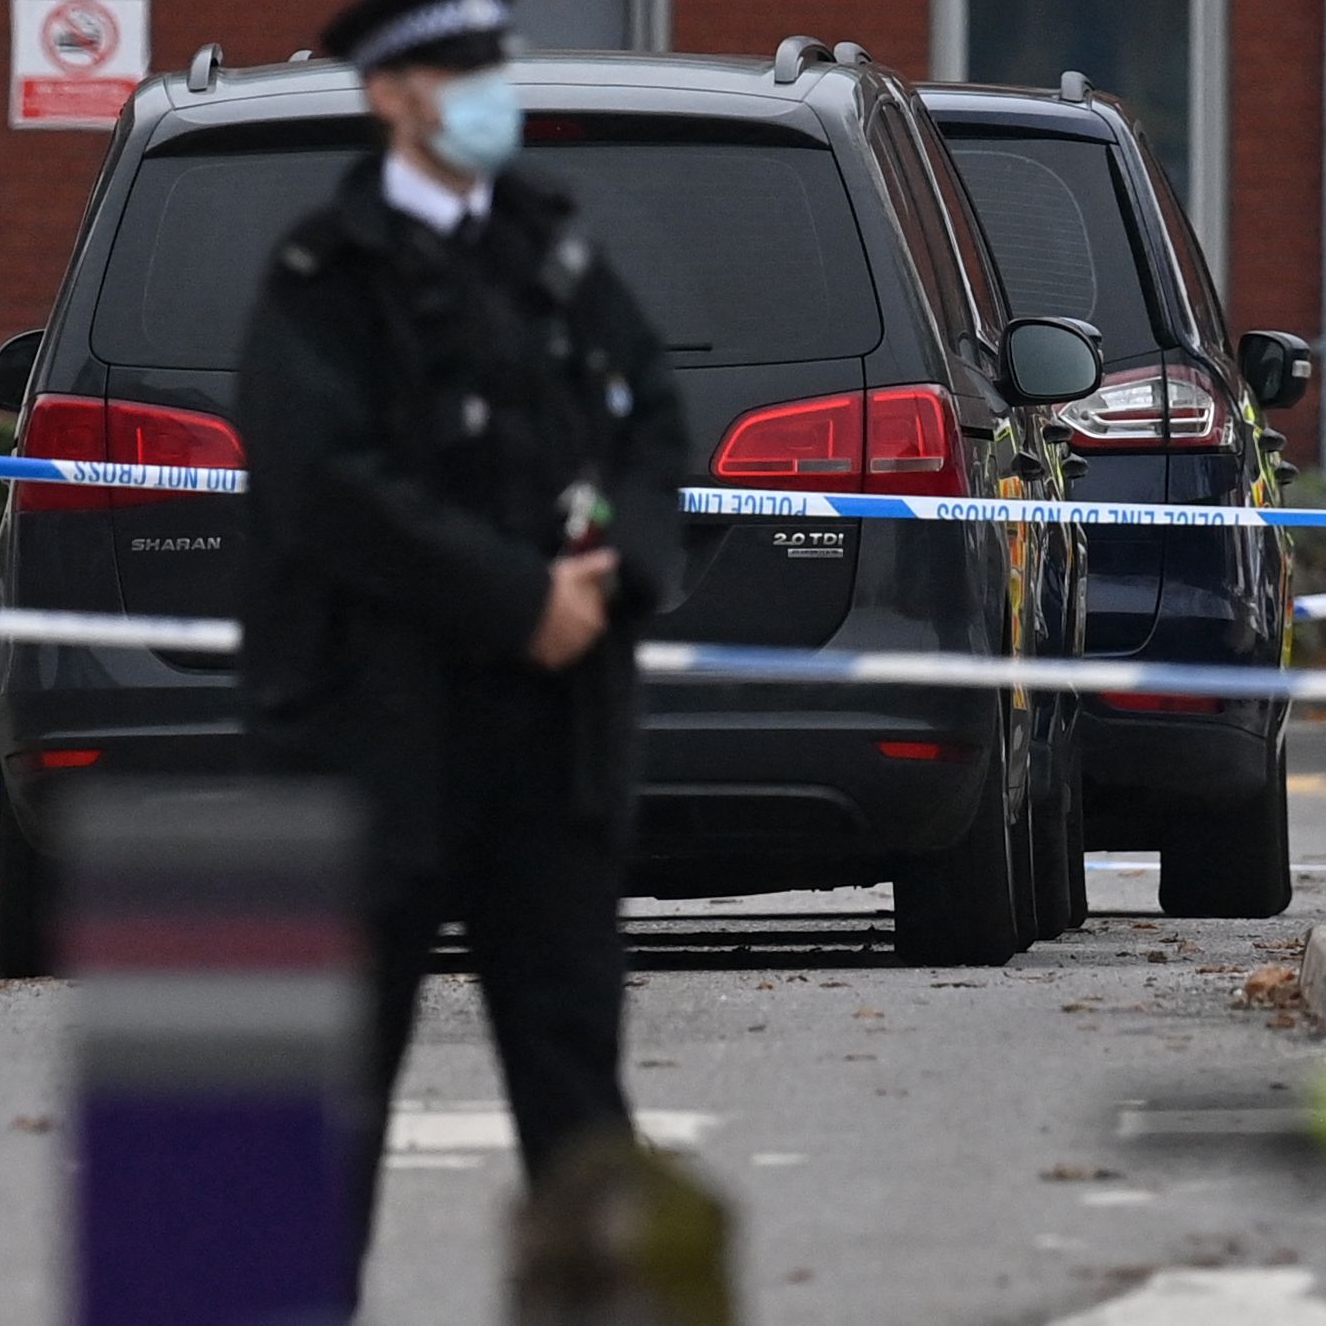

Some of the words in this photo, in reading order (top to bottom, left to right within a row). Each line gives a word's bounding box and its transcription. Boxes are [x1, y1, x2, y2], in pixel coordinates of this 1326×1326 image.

[73, 461, 147, 487] CROSS
[154, 465, 198, 490] NOT
[206, 469, 236, 492] DO
[731, 493, 807, 516] POLICE
[131, 536, 222, 552] SHARAN
[809, 532, 844, 546] TDI
